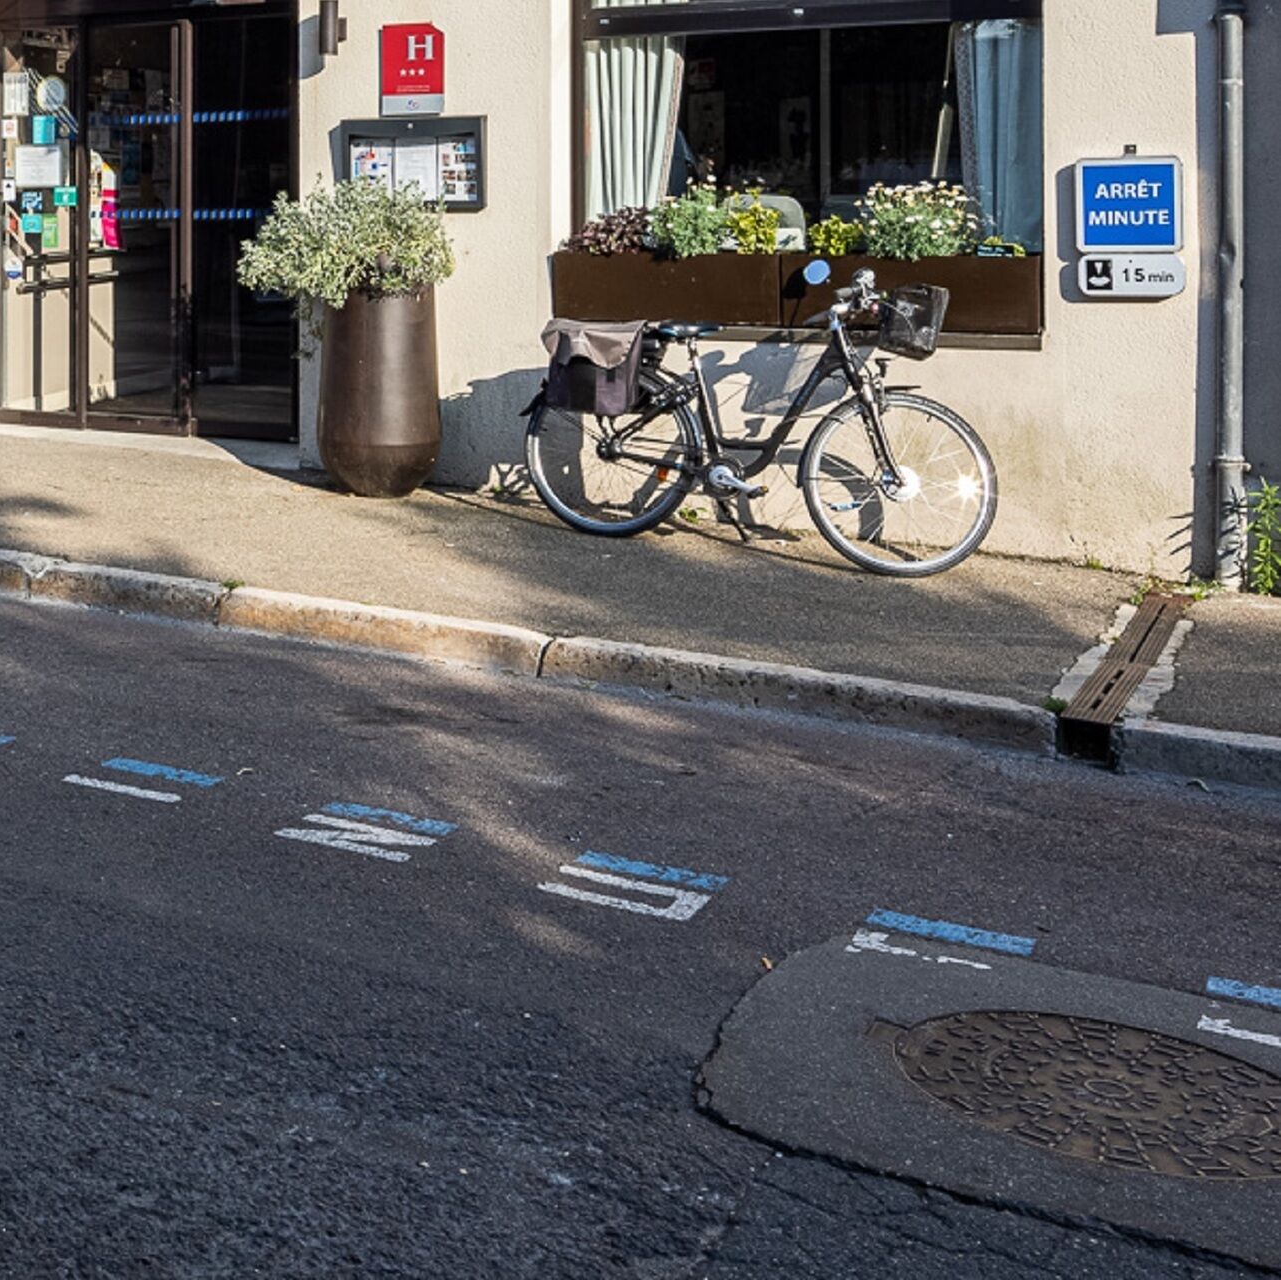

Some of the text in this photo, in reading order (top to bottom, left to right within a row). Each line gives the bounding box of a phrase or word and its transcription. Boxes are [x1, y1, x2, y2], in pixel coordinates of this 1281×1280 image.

[407, 33, 435, 62] H
[1094, 178, 1163, 200] ARRÊT
[1088, 209, 1171, 227] MINUTE
[1122, 267, 1176, 283] 15 min
